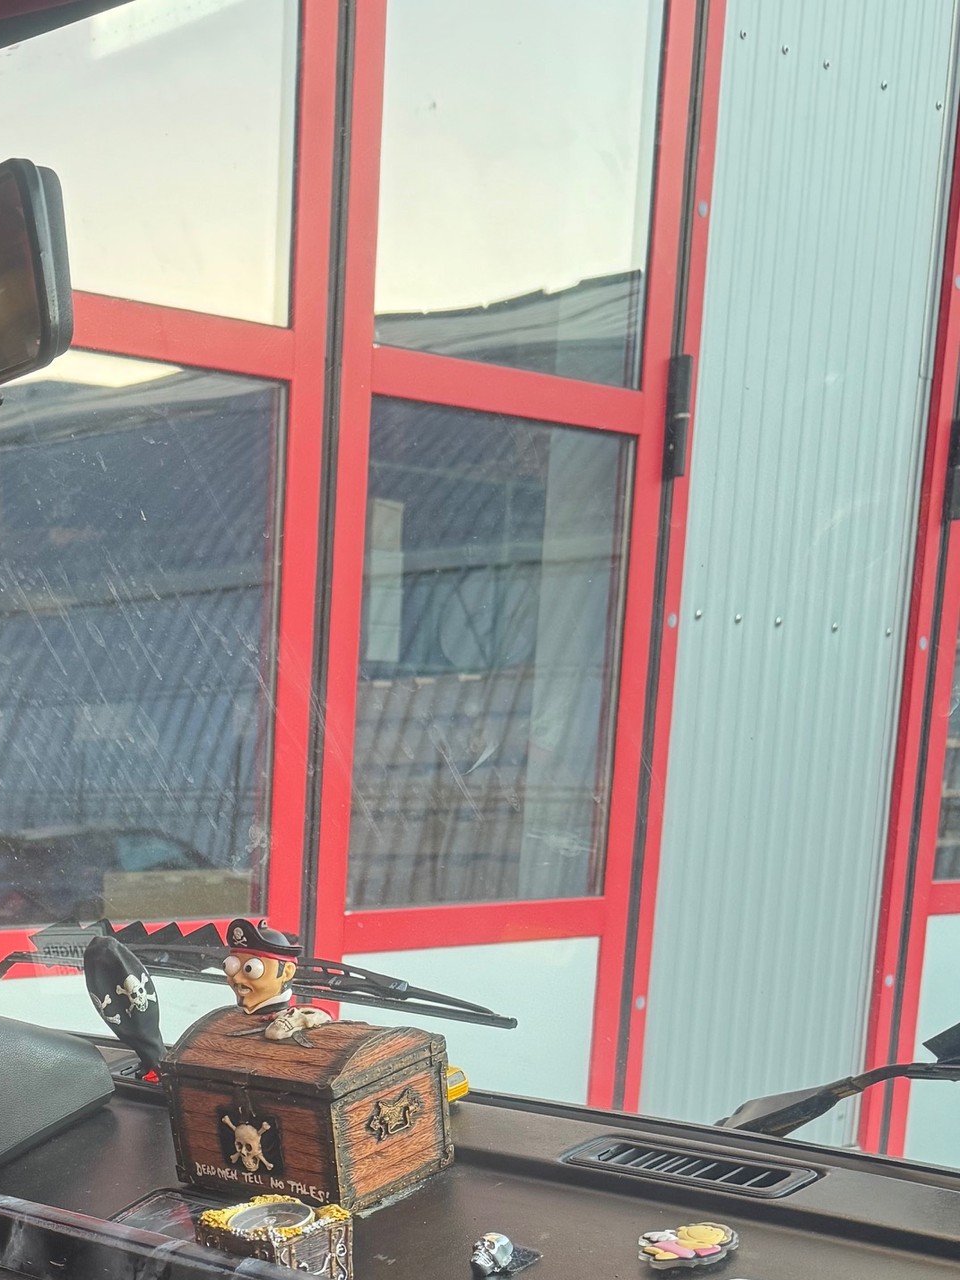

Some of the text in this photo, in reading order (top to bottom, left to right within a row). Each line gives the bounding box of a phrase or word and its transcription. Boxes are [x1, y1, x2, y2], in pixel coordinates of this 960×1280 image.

[195, 1162, 330, 1203] DEAD MEN TELL NO TALES!
